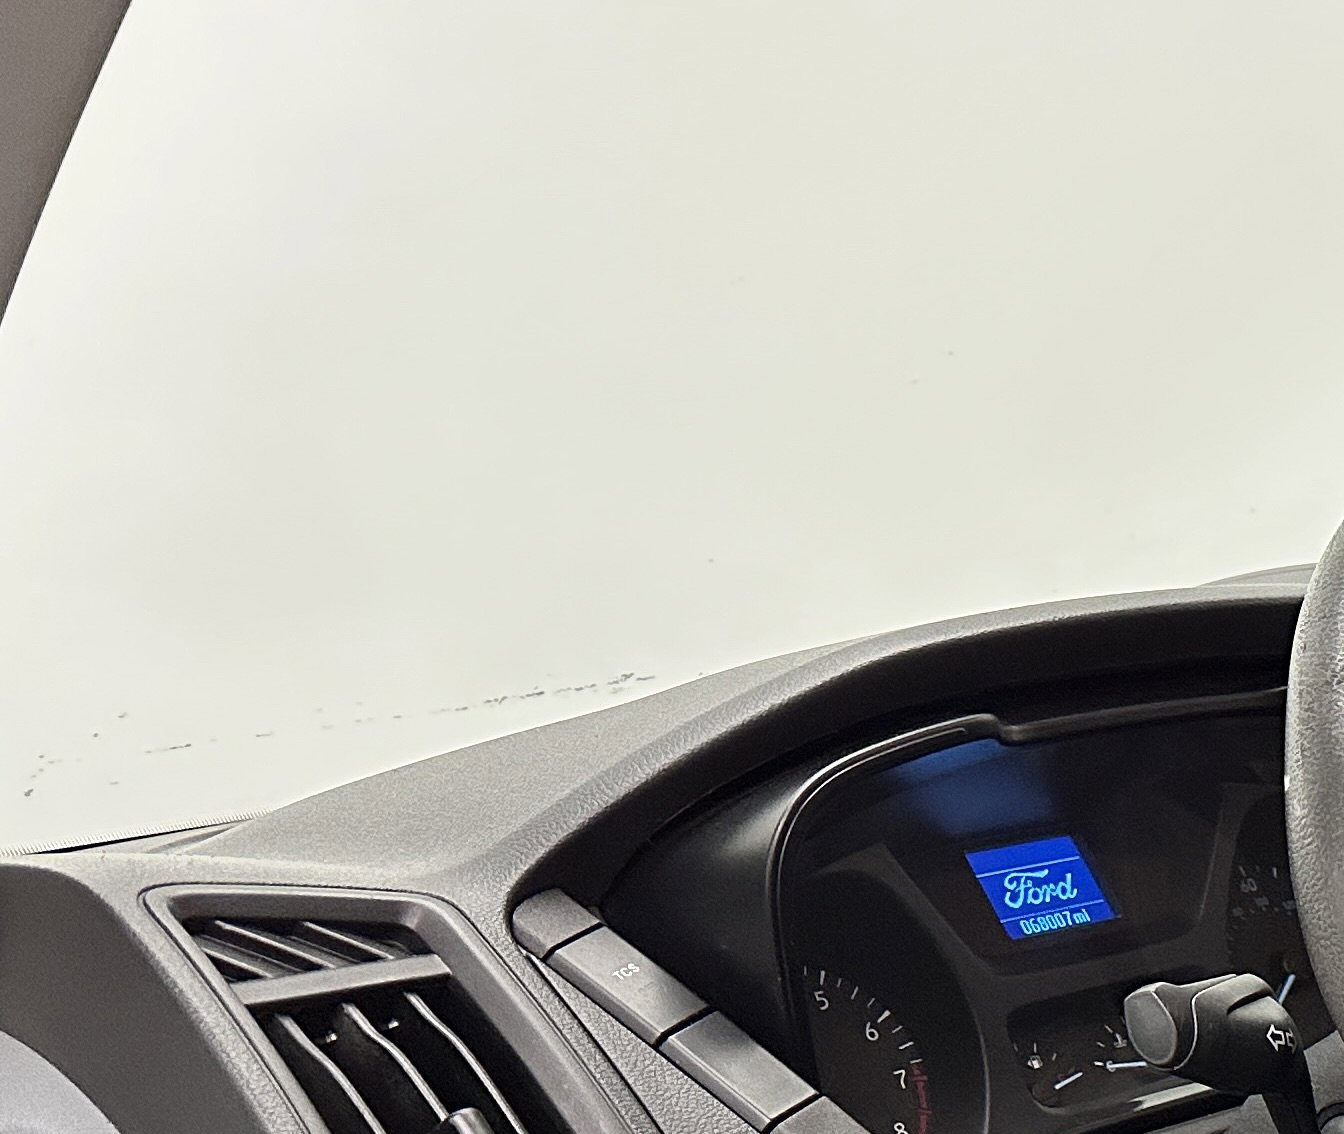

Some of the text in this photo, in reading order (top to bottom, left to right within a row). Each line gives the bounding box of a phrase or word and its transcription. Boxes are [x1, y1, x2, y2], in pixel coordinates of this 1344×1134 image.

[1003, 868, 1078, 909] Ford
[1239, 877, 1258, 893] 60
[611, 963, 641, 981] TCS
[814, 991, 829, 1011] 5
[865, 1021, 880, 1041] 6
[893, 1069, 907, 1089] 7
